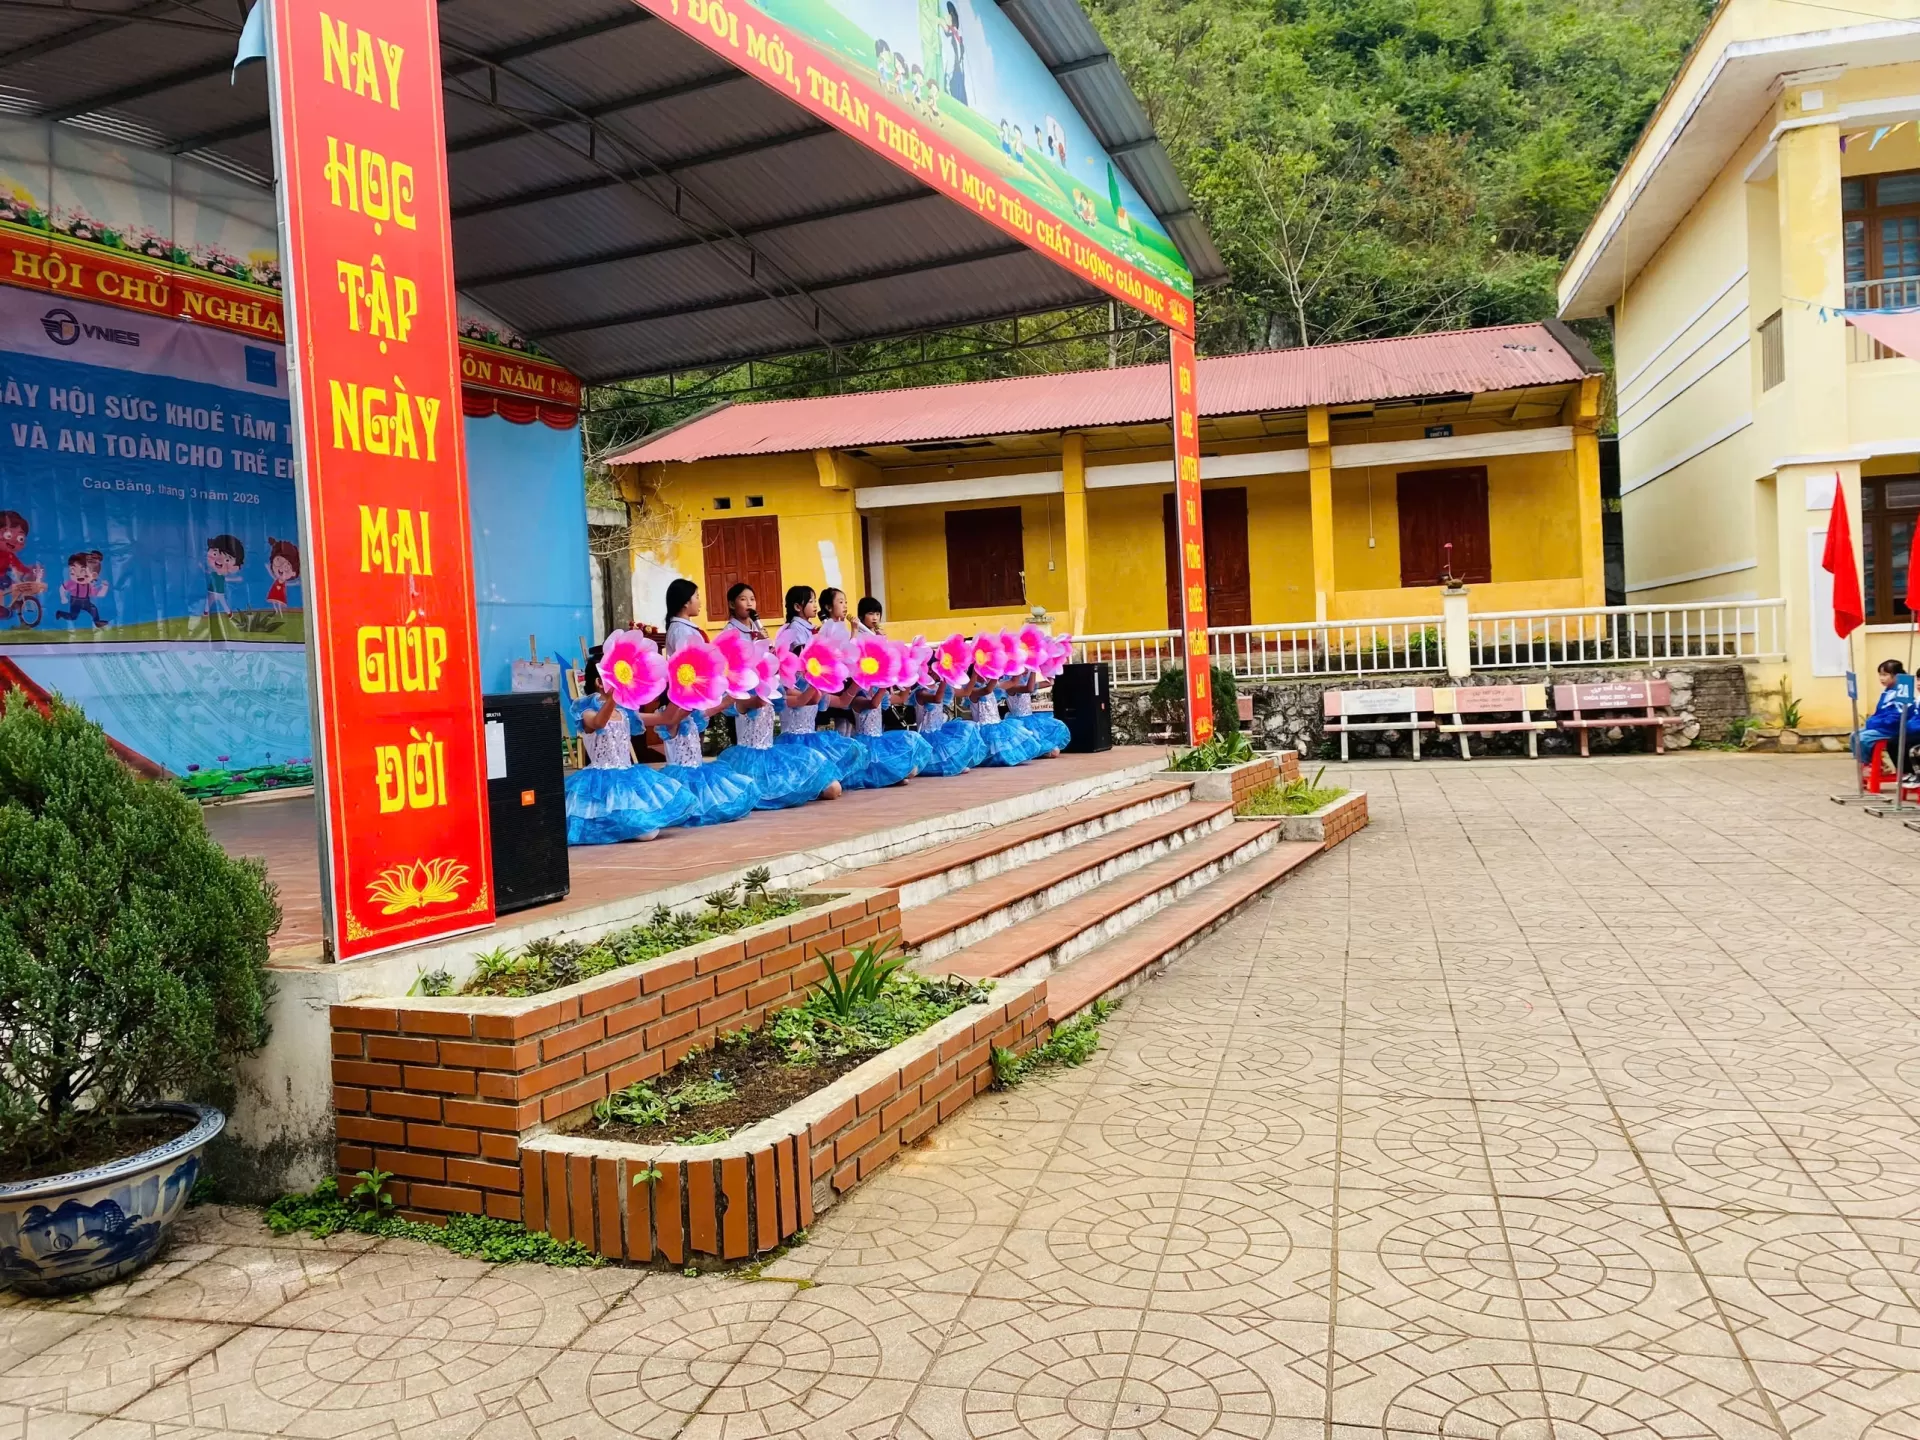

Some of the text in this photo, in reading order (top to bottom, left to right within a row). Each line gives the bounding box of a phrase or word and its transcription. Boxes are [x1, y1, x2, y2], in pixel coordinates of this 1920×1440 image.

[806, 66, 870, 132] THÂN
[875, 111, 934, 173] THIỆN
[937, 152, 958, 188] VÌ
[960, 168, 996, 212] MỤC
[999, 193, 1033, 235] TIÊU
[1036, 219, 1071, 259] CHẤT
[1073, 243, 1114, 284] LƯỢNG
[1115, 269, 1142, 300] GIÁO
[1144, 285, 1164, 313] DỤC
[12, 250, 84, 289] HỘI
[96, 271, 170, 307] CHỦ
[182, 290, 283, 334] NGHĨA
[499, 365, 544, 392] NĂM
[82, 323, 140, 347] VNIES
[49, 385, 96, 418] HỘI
[105, 393, 158, 422] SỨC
[166, 403, 225, 432] KHOẺ
[231, 413, 275, 441] TÂM
[319, 11, 448, 814] NAY HỌC TẬP NGÀY MAI GIÚP ĐỜI
[11, 421, 49, 449] VÀ
[58, 428, 96, 455] AN
[103, 433, 171, 462] TOÀN
[175, 443, 223, 469] CHO
[231, 448, 268, 475] TRẺ
[82, 477, 112, 490] Cao
[190, 488, 197, 498] 3
[200, 489, 228, 501] năm
[233, 492, 260, 504] 2026
